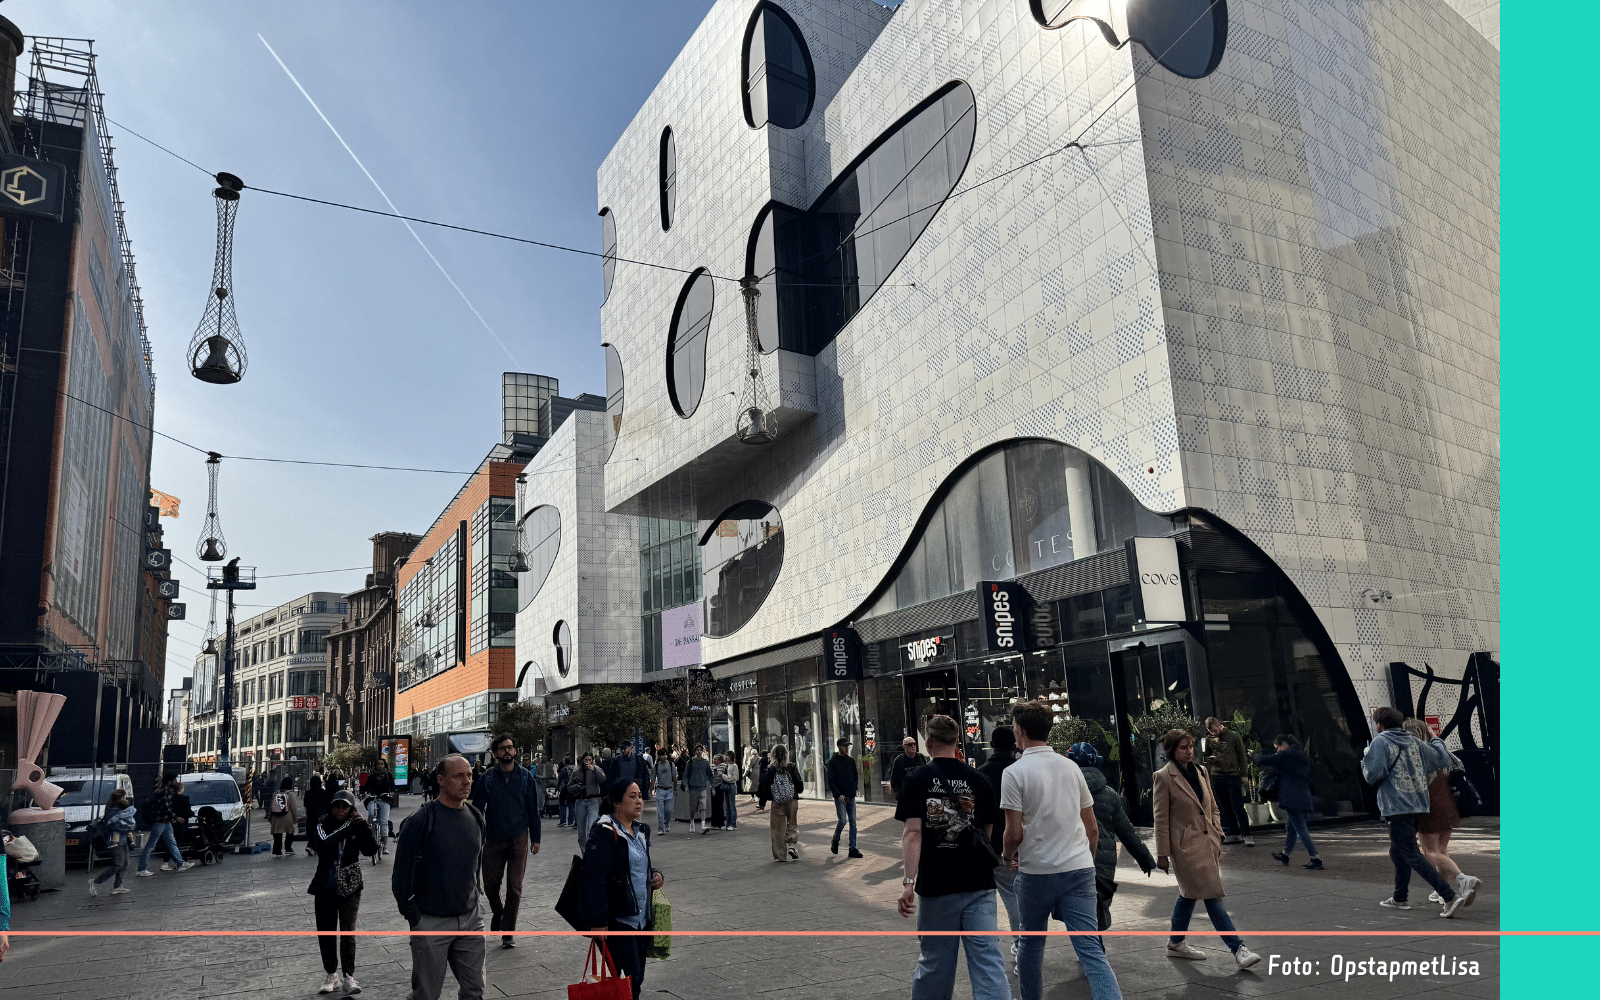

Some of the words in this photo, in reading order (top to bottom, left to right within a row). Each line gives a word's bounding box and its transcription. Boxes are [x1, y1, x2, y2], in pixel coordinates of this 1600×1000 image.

[992, 530, 1075, 571] COTES
[1141, 572, 1179, 586] cove
[992, 590, 1015, 647] snipes
[833, 636, 849, 676] snipes
[907, 637, 938, 662] snipes
[951, 779, 968, 788] 1984
